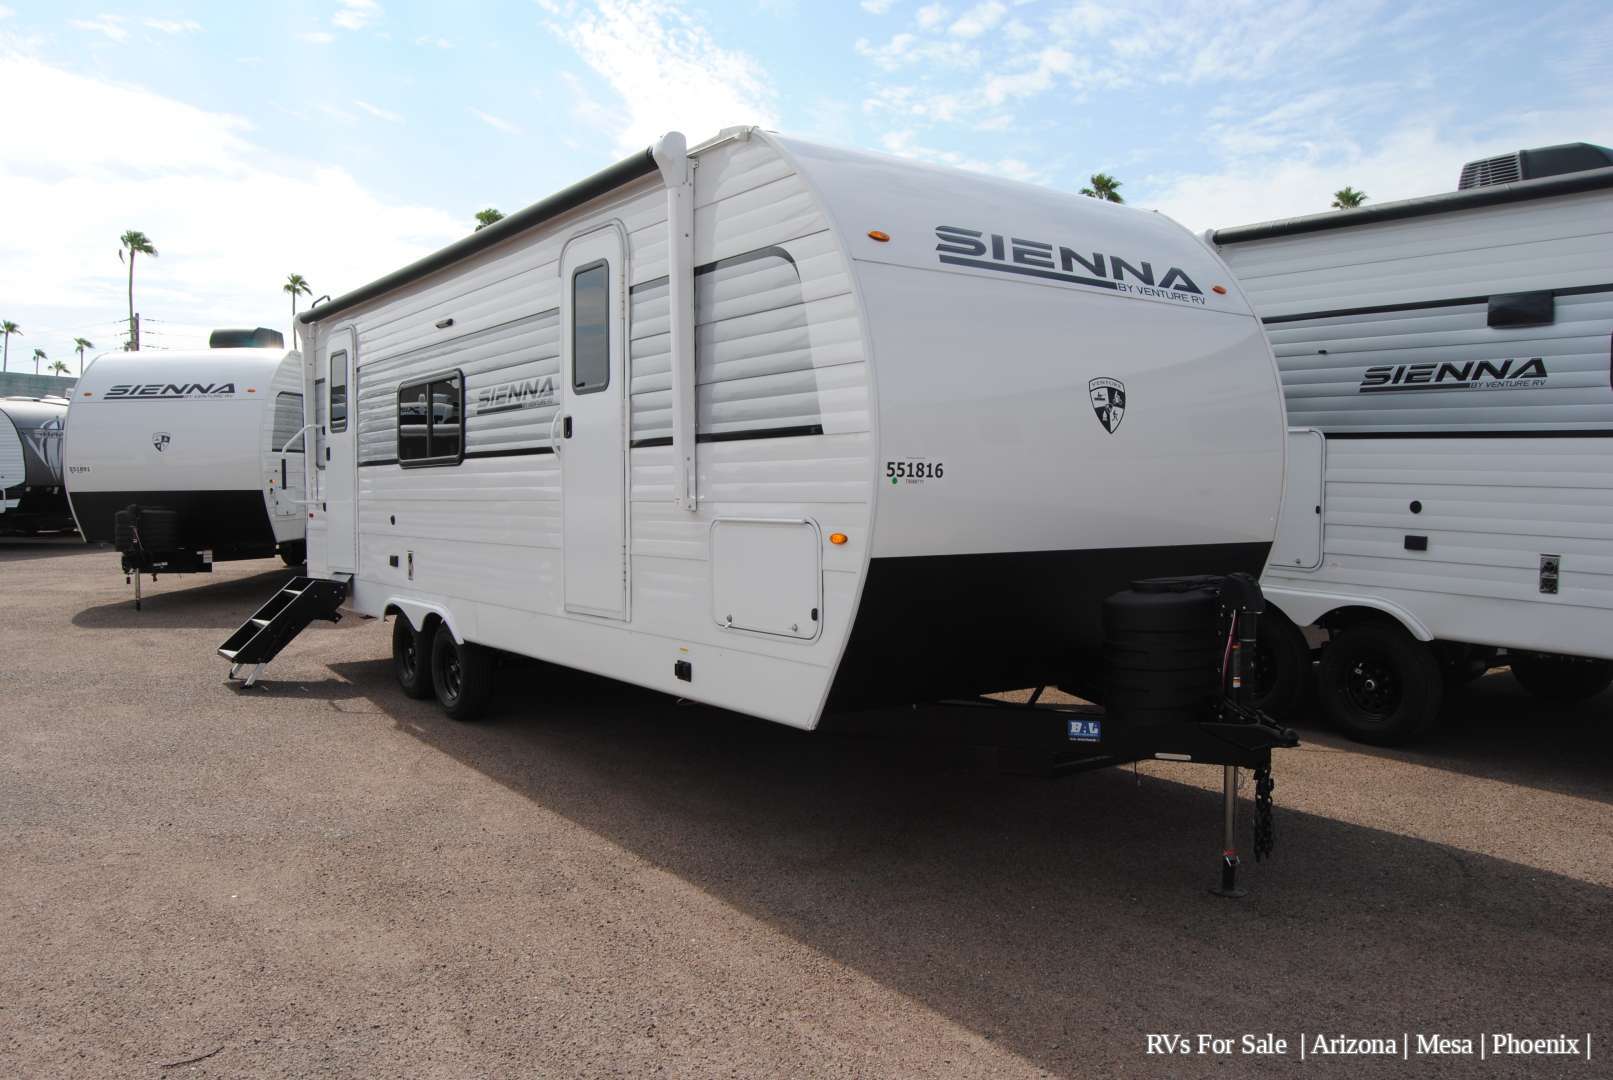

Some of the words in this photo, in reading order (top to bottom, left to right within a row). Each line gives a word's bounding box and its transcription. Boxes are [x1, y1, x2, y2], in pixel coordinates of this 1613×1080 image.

[936, 225, 1204, 295] SIENNA
[1117, 282, 1133, 292] BY
[1136, 286, 1189, 303] VENTURE
[1191, 295, 1205, 305] RV
[1360, 357, 1548, 386] SIENNA
[105, 383, 235, 396] SIENNA
[477, 377, 554, 408] SIENNA
[1486, 380, 1529, 388] VENTURE
[886, 461, 944, 478] 551816
